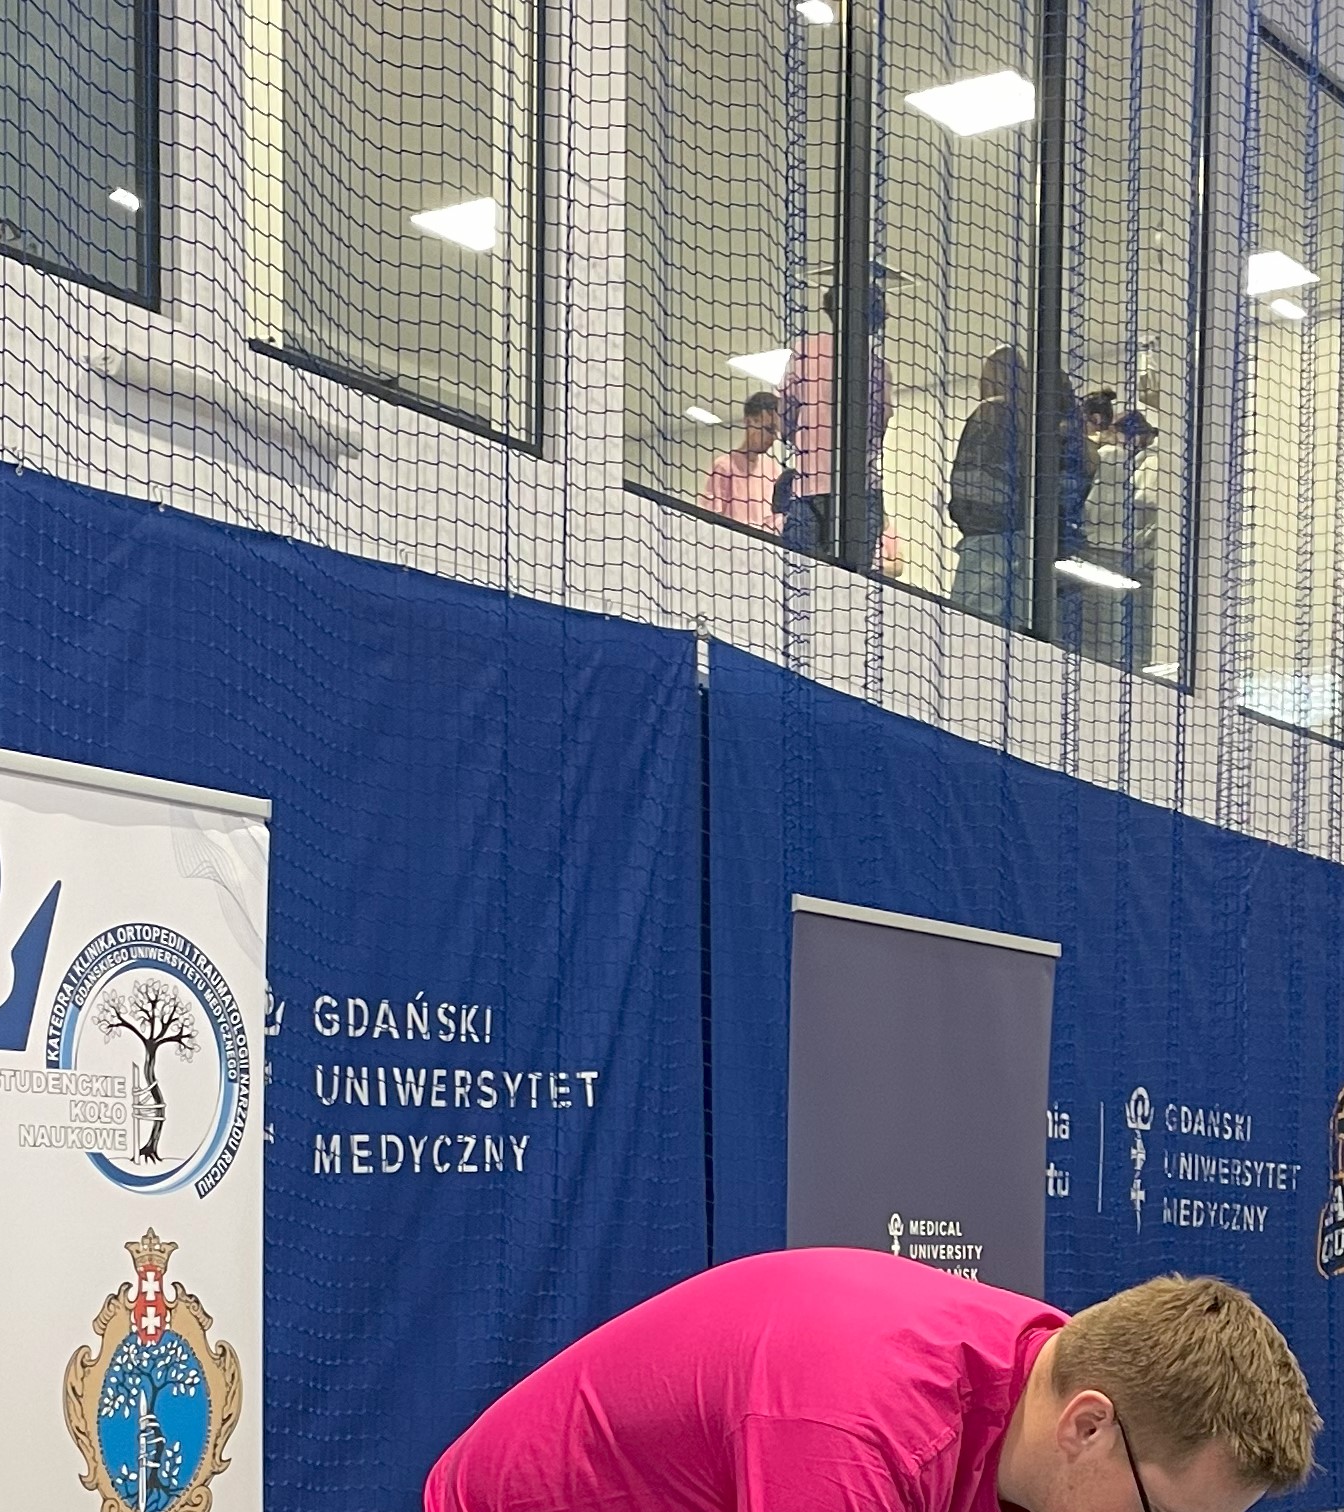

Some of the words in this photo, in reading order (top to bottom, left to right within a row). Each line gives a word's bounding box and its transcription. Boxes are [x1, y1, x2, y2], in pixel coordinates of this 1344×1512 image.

[73, 932, 117, 976] KLINIKA
[117, 925, 185, 952] ORTOPEDII
[47, 983, 74, 1061] KATEDRA
[130, 946, 206, 990] UNIWERSYTETU
[204, 988, 237, 1080] MEDYCZNEGO
[192, 948, 249, 1069] TRAUMATOLOGII
[313, 991, 493, 1043] GDAŃSKI
[315, 1065, 599, 1109] UNIWERSYTET
[70, 1100, 128, 1125] KOŁO
[1165, 1103, 1253, 1142] GDAŃSKI
[19, 1124, 128, 1150] NAUKOWE
[313, 1134, 530, 1174] MEDYCZNY
[199, 1152, 234, 1195] RUCHU
[909, 1220, 962, 1236] MEDICAL
[909, 1244, 983, 1260] UNIVERSITY
